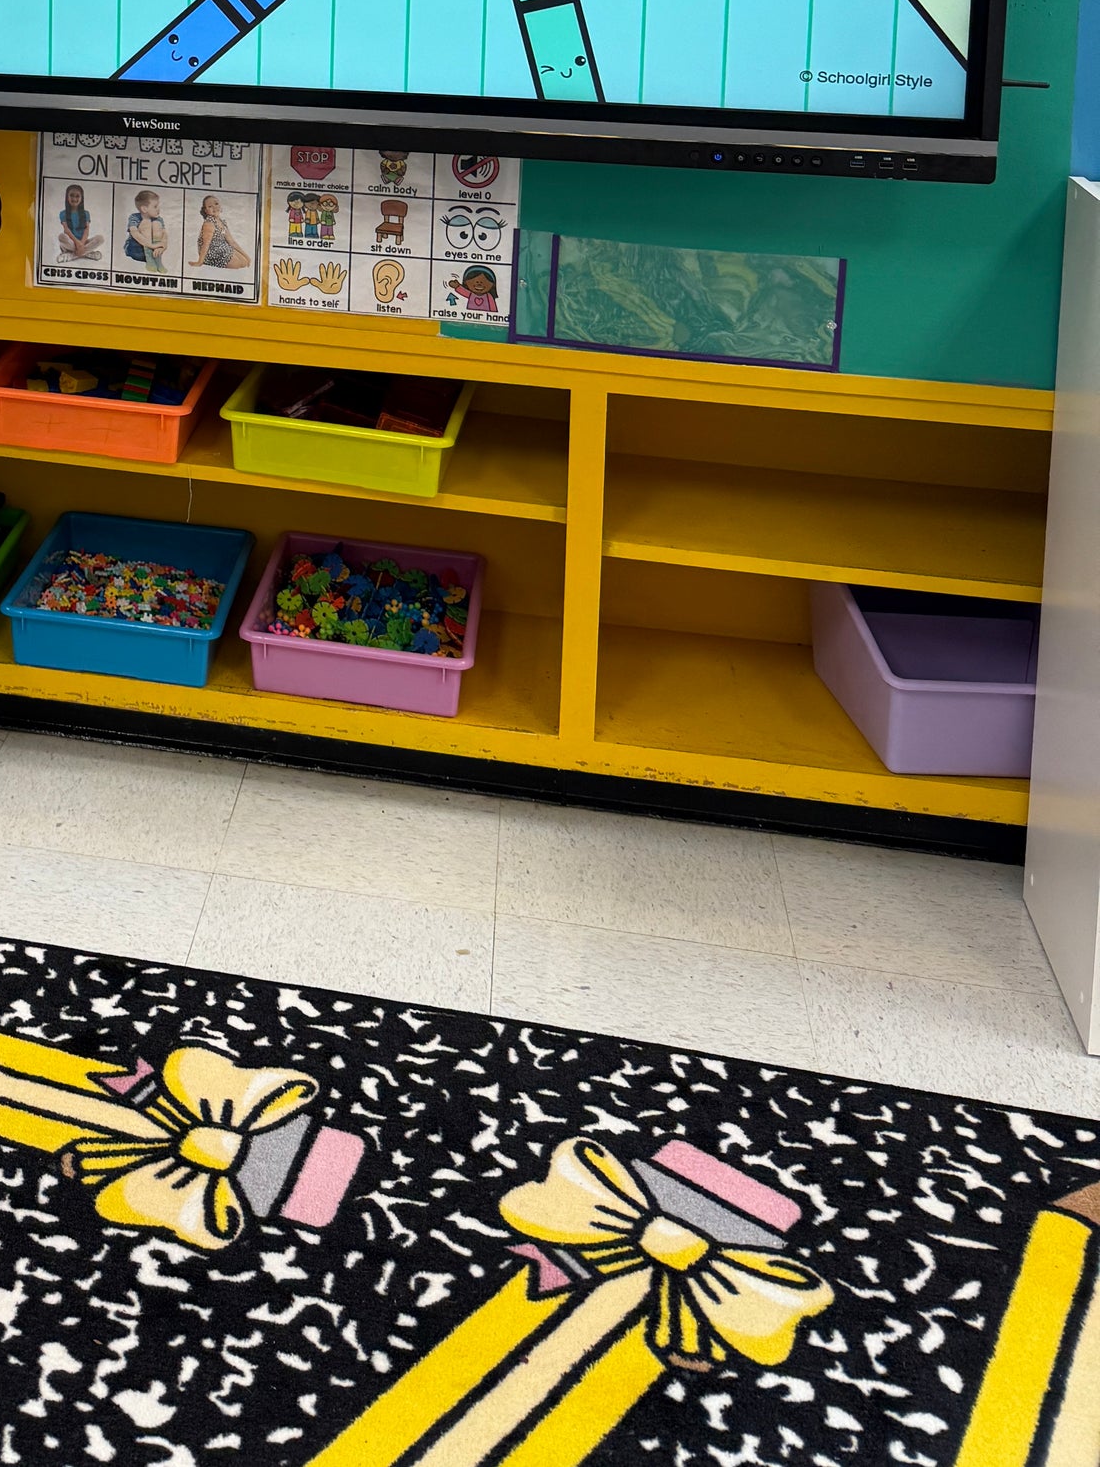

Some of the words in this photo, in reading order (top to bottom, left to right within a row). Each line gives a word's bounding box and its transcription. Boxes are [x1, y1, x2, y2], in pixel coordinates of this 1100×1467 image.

[817, 71, 891, 88] Schoolgirl
[895, 74, 933, 90] Style
[123, 117, 181, 130] ViewSonic
[297, 151, 329, 163] STOP
[78, 154, 108, 177] ON
[116, 156, 150, 181] THE
[303, 181, 325, 189] better
[327, 183, 350, 191] choice
[367, 184, 391, 194] calm
[393, 186, 418, 196] body
[458, 190, 482, 200] level
[288, 237, 304, 246] line
[306, 239, 334, 249] order
[370, 243, 382, 253] sit
[385, 245, 411, 255] down
[444, 251, 468, 261] eyes
[471, 252, 483, 260] on
[486, 253, 502, 262] me
[43, 268, 73, 279] CRISS
[75, 270, 109, 281] CROSS
[115, 273, 178, 289] MOUNTAIN
[192, 280, 244, 295] MERMAID
[279, 296, 307, 306] hands
[309, 297, 319, 307] to
[321, 298, 340, 309] self
[376, 304, 402, 314] listen
[432, 309, 458, 318] raise
[460, 312, 484, 322] your
